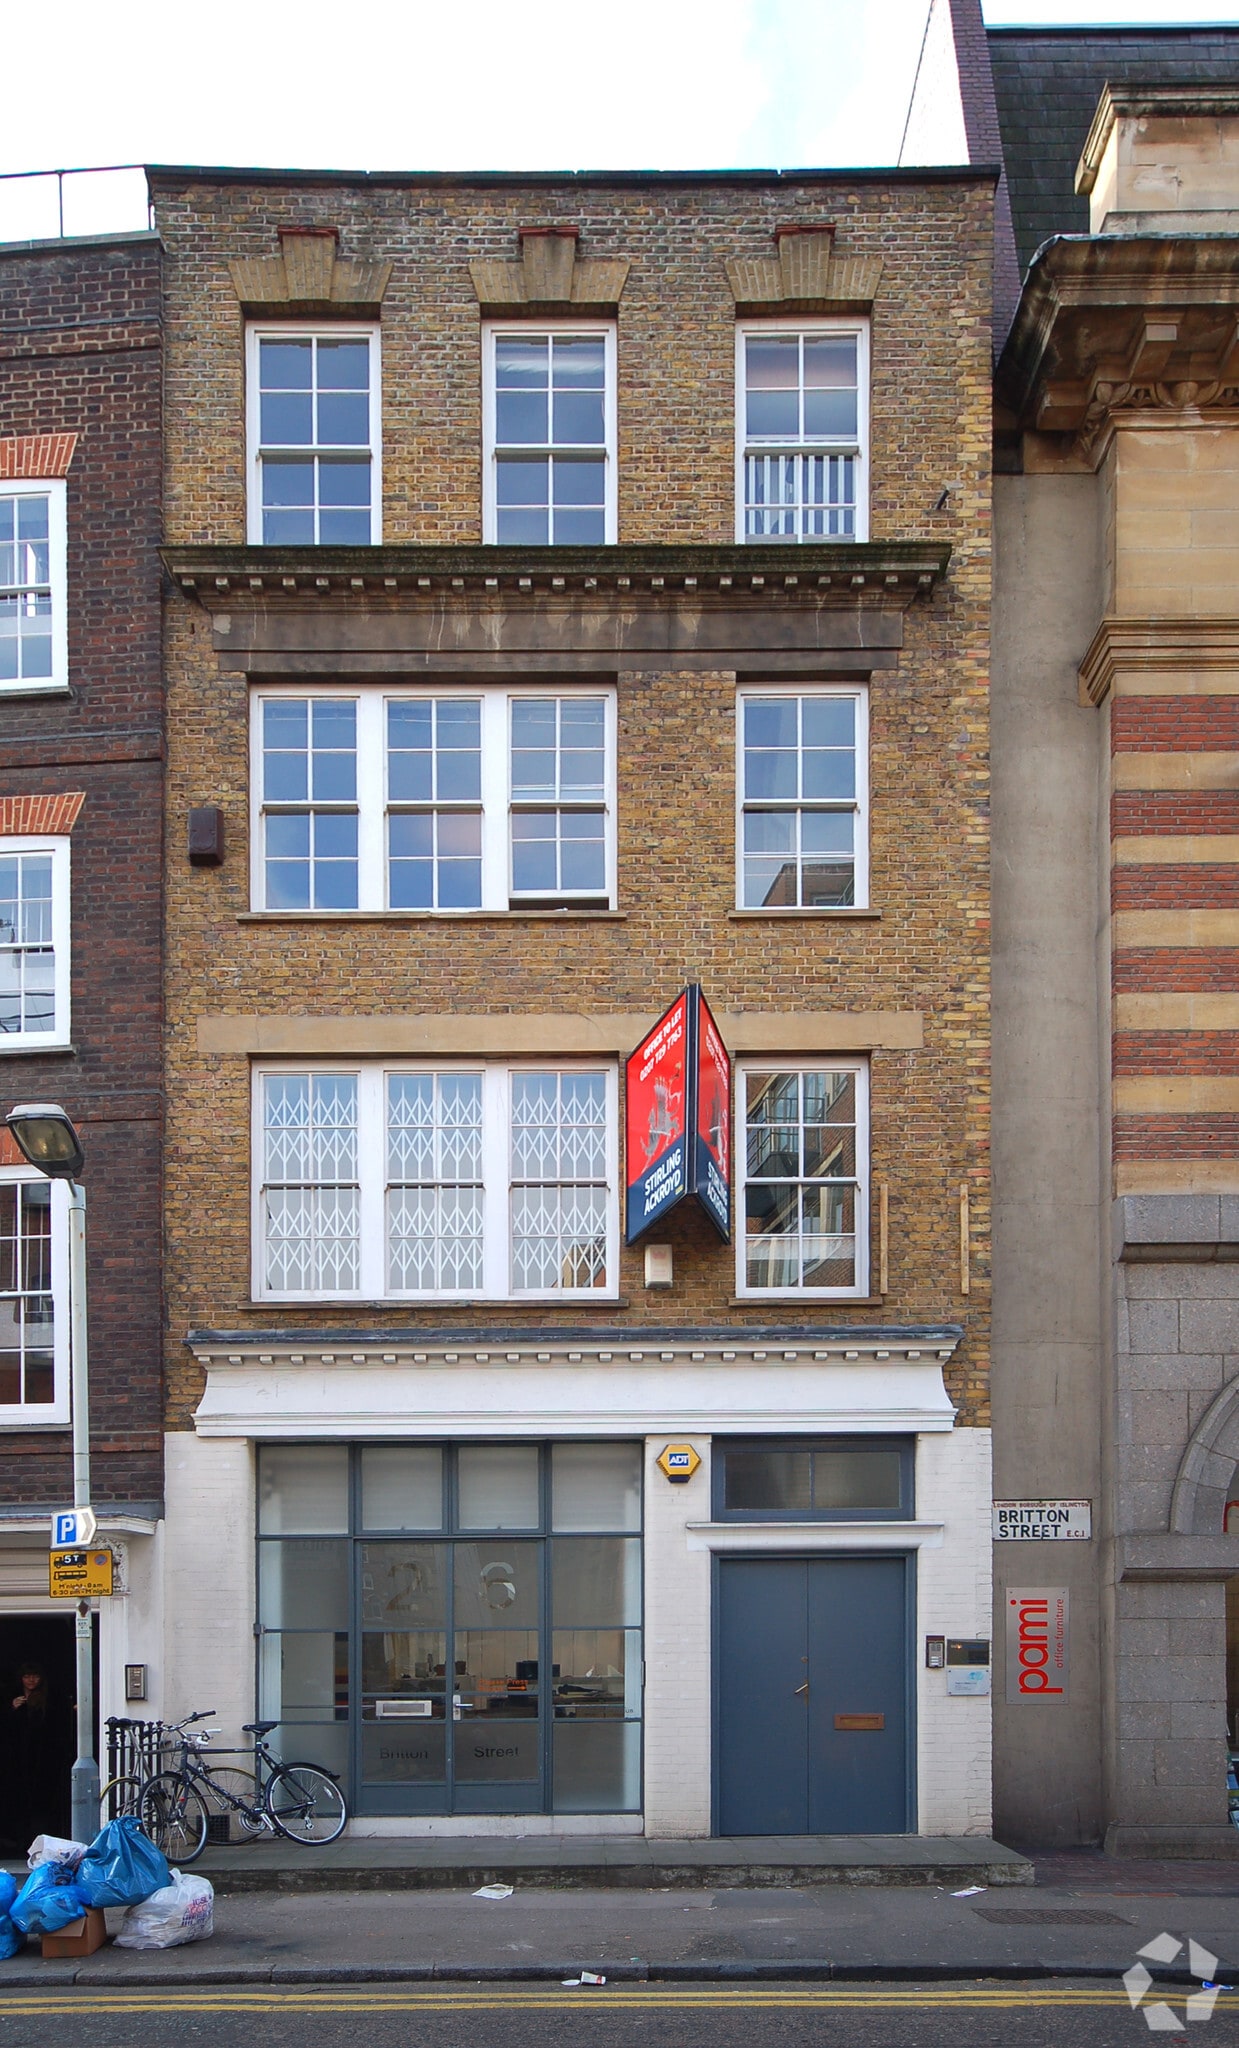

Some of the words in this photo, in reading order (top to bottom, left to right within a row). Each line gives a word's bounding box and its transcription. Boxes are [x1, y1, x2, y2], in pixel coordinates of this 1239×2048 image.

[643, 1030, 663, 1060] OFFICE
[663, 1021, 671, 1037] TO
[672, 1007, 682, 1028] LET
[644, 1148, 681, 1196] STIRLING
[643, 1169, 681, 1216] ACKROYD
[669, 1455, 689, 1465] ADT
[61, 1517, 75, 1541] P
[999, 1510, 1069, 1523] BRITTON
[999, 1525, 1061, 1538] STREET
[1054, 1598, 1064, 1640] furniture
[1010, 1599, 1063, 1694] pami
[1054, 1642, 1064, 1669] office
[473, 1745, 519, 1758] Street
